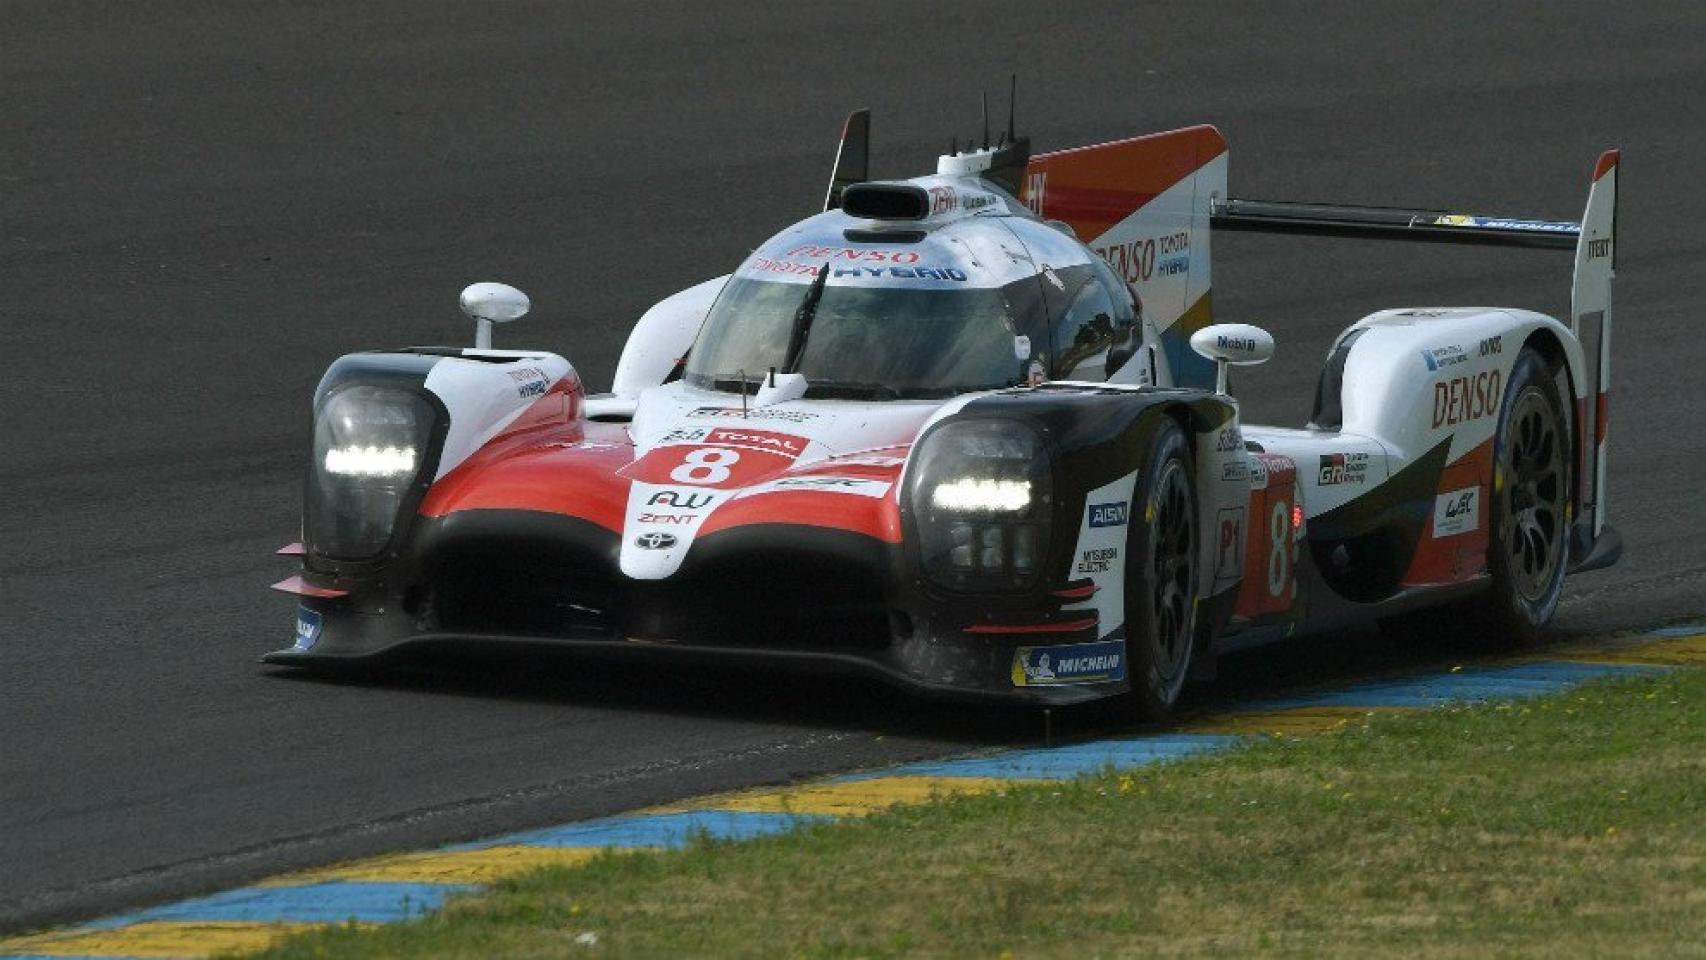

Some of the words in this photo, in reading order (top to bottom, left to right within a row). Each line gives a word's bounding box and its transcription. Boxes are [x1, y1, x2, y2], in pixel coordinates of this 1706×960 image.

[787, 246, 920, 263] DENSO
[833, 266, 967, 282] HYBRID
[1432, 370, 1500, 429] DENSO
[716, 432, 799, 451] TOTAL
[671, 446, 740, 484] 8
[1268, 501, 1288, 598] 8
[1057, 654, 1120, 674] MICHELIN
